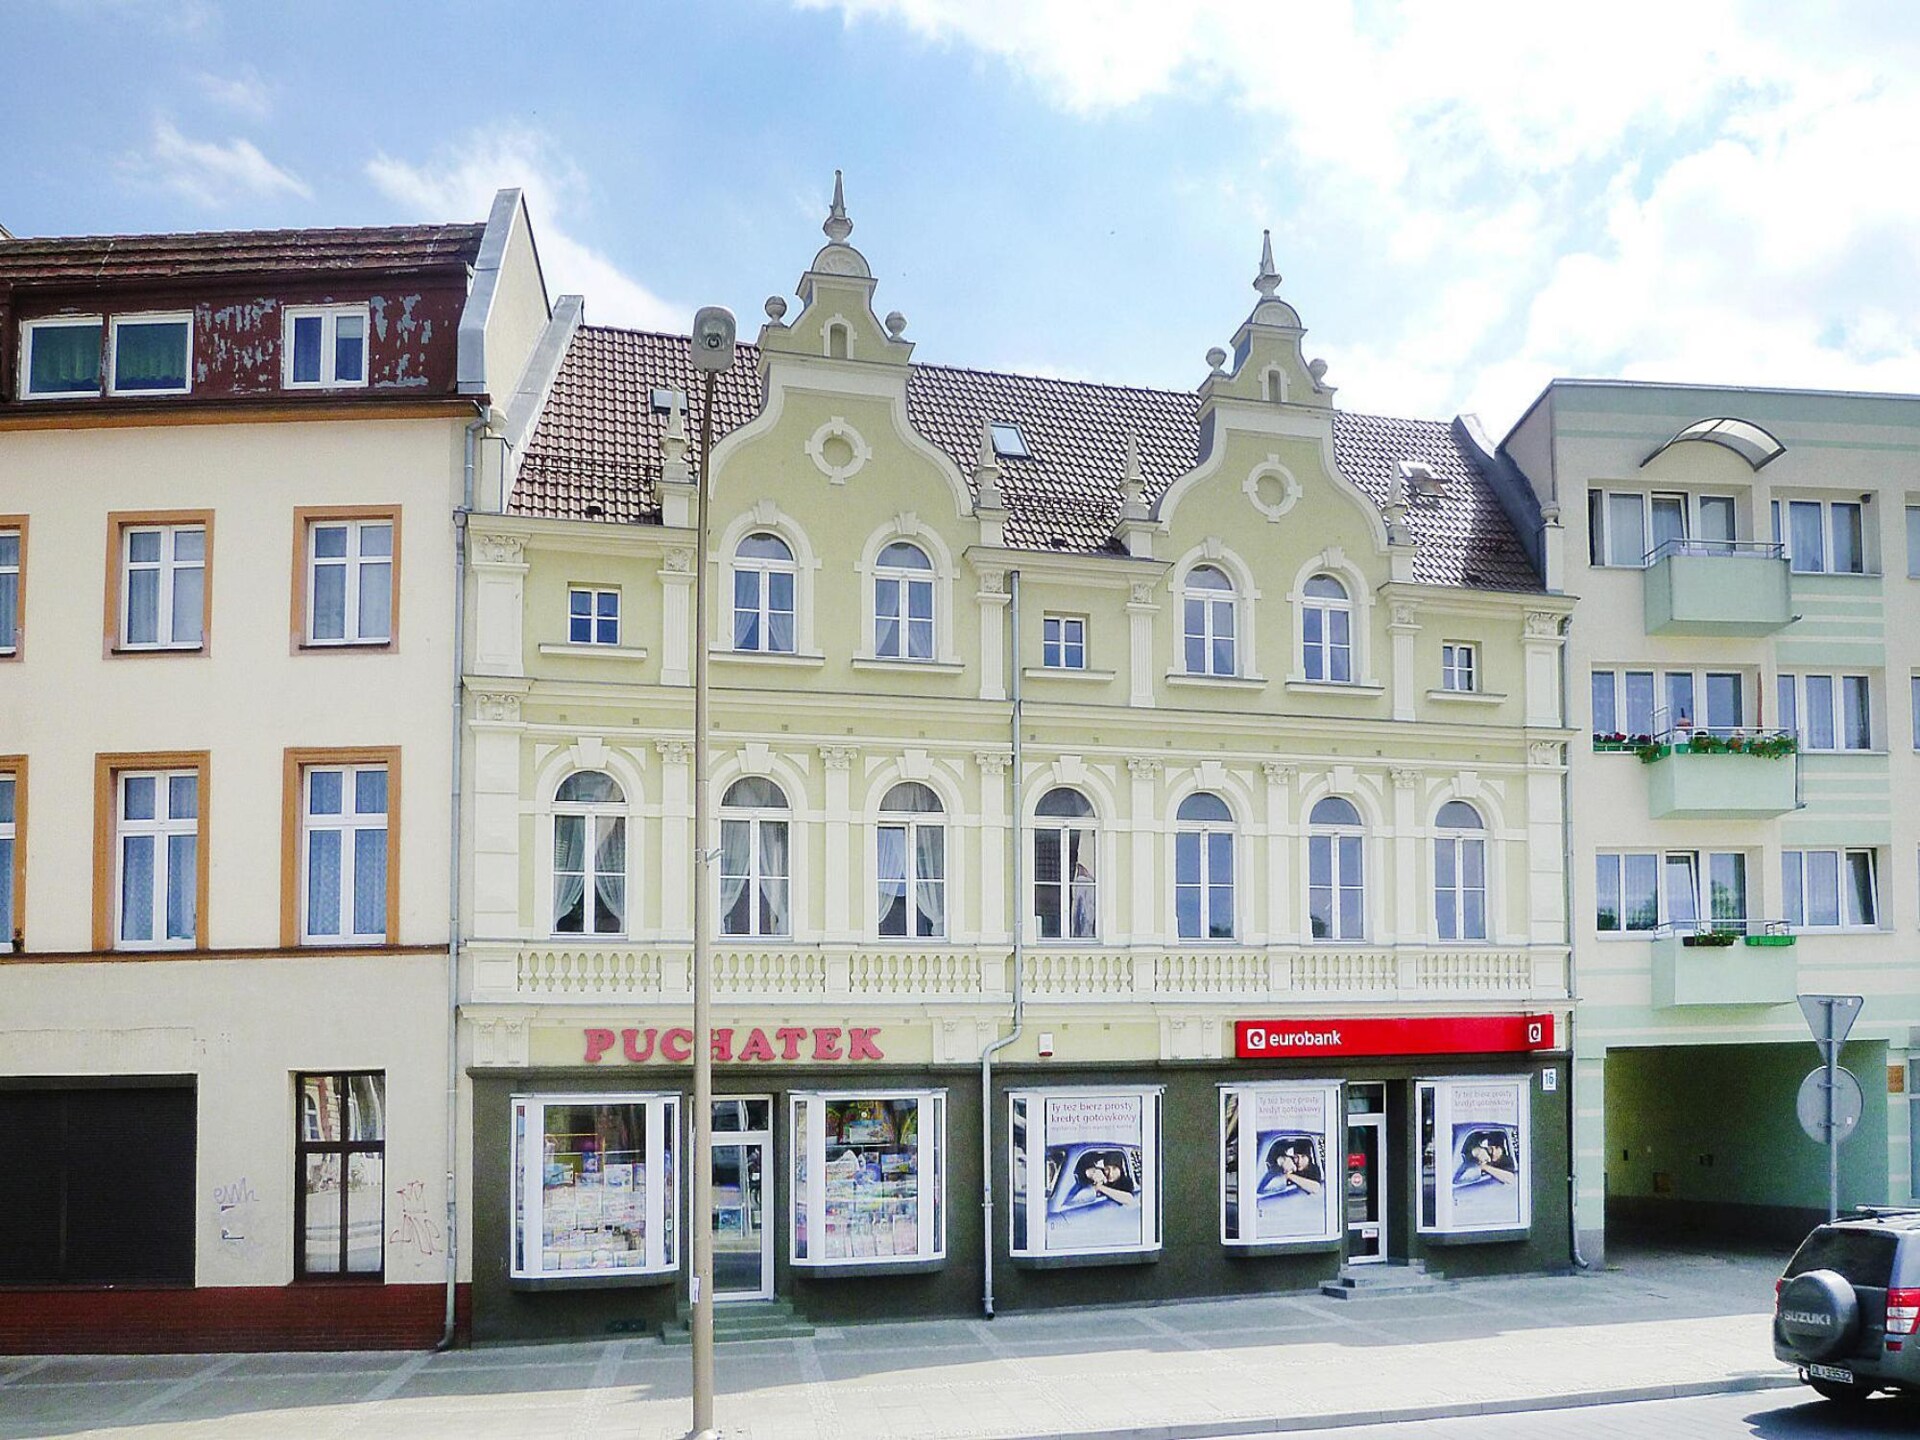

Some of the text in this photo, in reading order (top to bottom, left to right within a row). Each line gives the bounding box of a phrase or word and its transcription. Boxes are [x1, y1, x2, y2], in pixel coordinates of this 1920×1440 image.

[583, 1027, 885, 1062] PUCHATEK
[1269, 1030, 1342, 1046] eurobank
[1104, 1102, 1133, 1113] prosty
[1051, 1114, 1080, 1123] kredyt
[1784, 1311, 1832, 1326] SUZUKI
